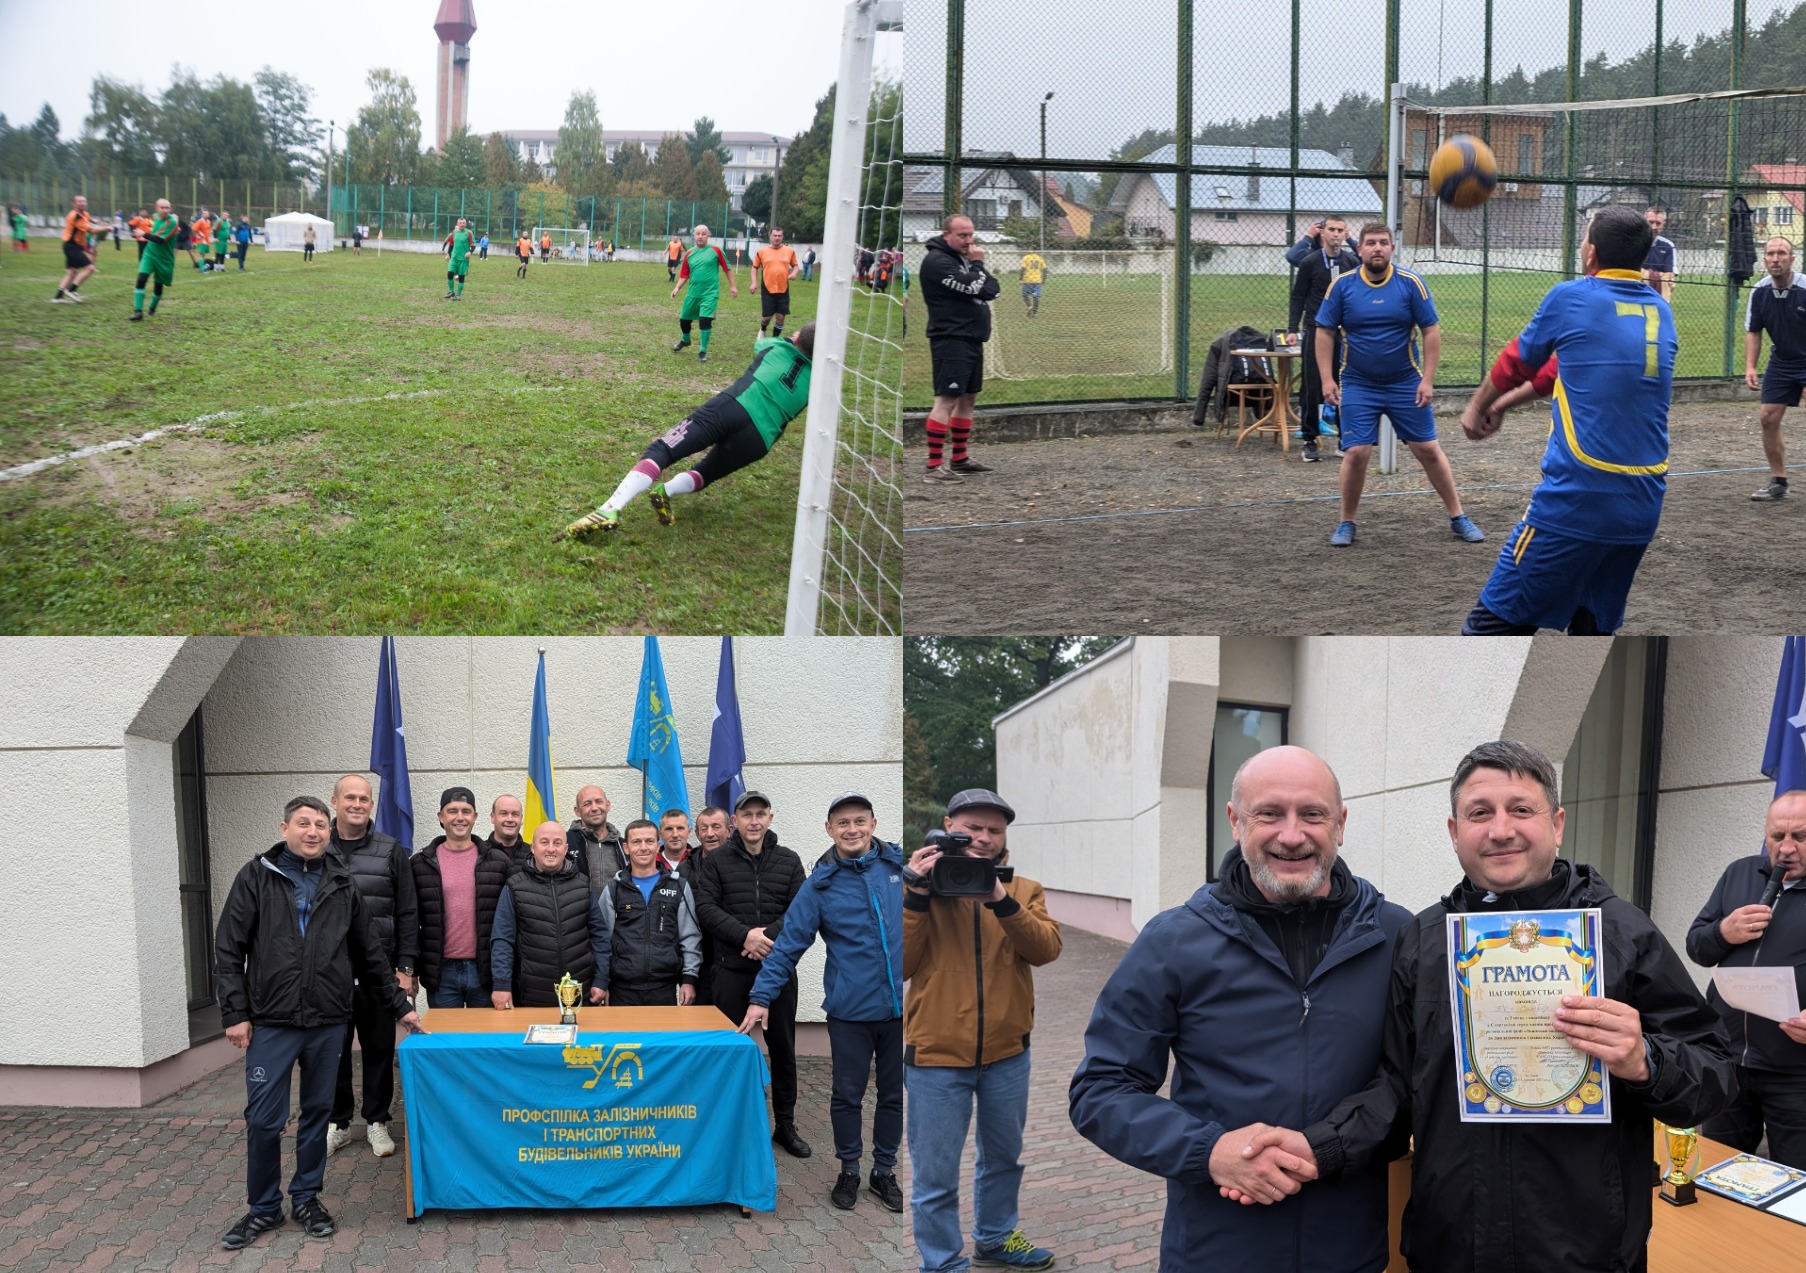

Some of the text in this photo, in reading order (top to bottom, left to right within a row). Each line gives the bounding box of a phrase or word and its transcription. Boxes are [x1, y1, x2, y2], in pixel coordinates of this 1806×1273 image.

[1276, 333, 1287, 345] 1
[1614, 301, 1660, 377] 7
[779, 354, 808, 393] 1
[659, 888, 677, 897] OFF
[1482, 965, 1571, 983] ГРАМОТА
[502, 1105, 697, 1123] ПРОФСПІЛКА ЗАЛІЗНИЧНИКІВ
[544, 1126, 656, 1141] І ТРАНСПОРТНИХ
[518, 1143, 681, 1164] БУДІВЕЛЬНИКІВ УКРАЇНИ
